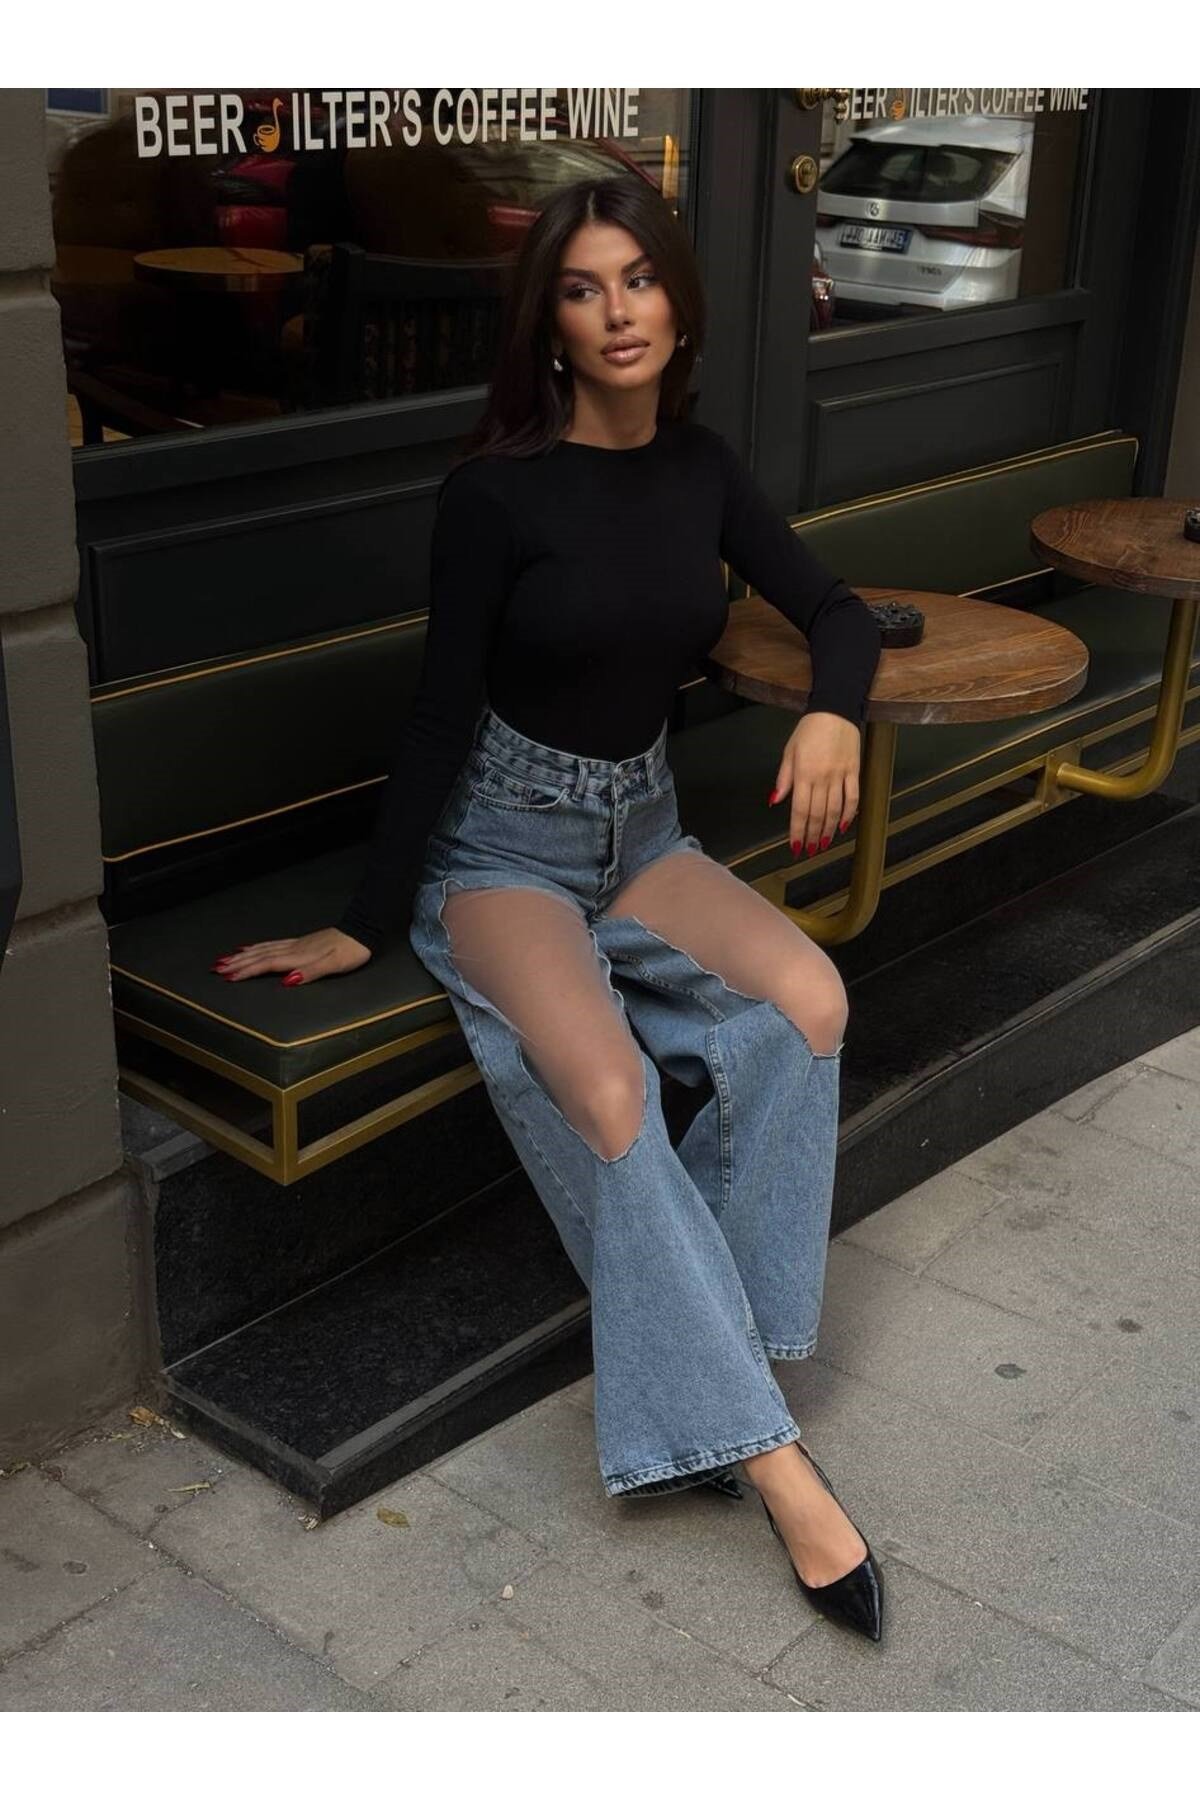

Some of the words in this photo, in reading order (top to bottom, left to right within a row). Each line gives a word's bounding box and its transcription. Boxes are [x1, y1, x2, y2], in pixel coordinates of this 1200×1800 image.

[135, 95, 248, 158] BEER
[292, 90, 422, 150] ILTER'S
[433, 88, 558, 146] COFFEE
[567, 88, 640, 140] WINE
[980, 88, 1045, 114] COFFEE
[1049, 88, 1089, 112] WINE
